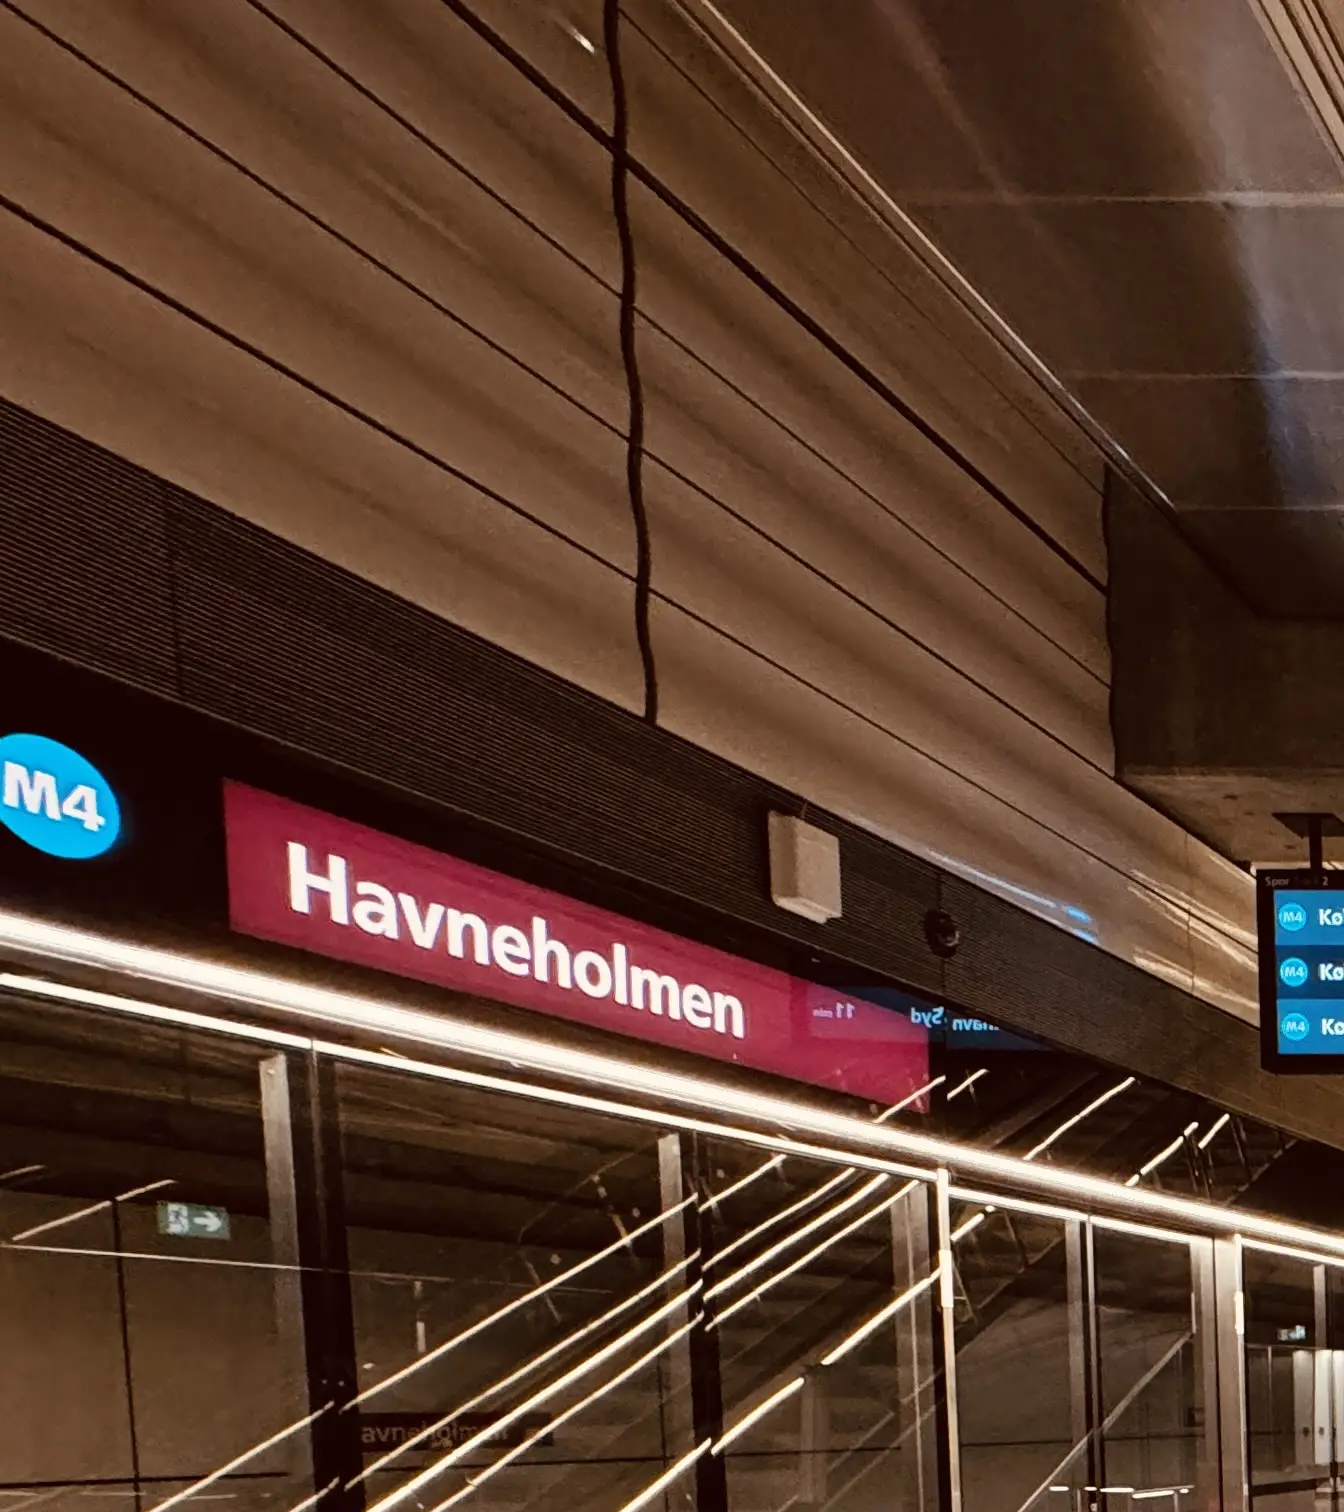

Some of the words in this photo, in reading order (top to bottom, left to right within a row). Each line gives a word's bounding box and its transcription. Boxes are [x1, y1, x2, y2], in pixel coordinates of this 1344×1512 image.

[3, 761, 106, 832] M4
[1322, 876, 1329, 886] 2
[1283, 911, 1303, 923] M4
[286, 841, 746, 1039] Havneholmen
[1284, 966, 1304, 978] M4
[1284, 1021, 1305, 1032] M4
